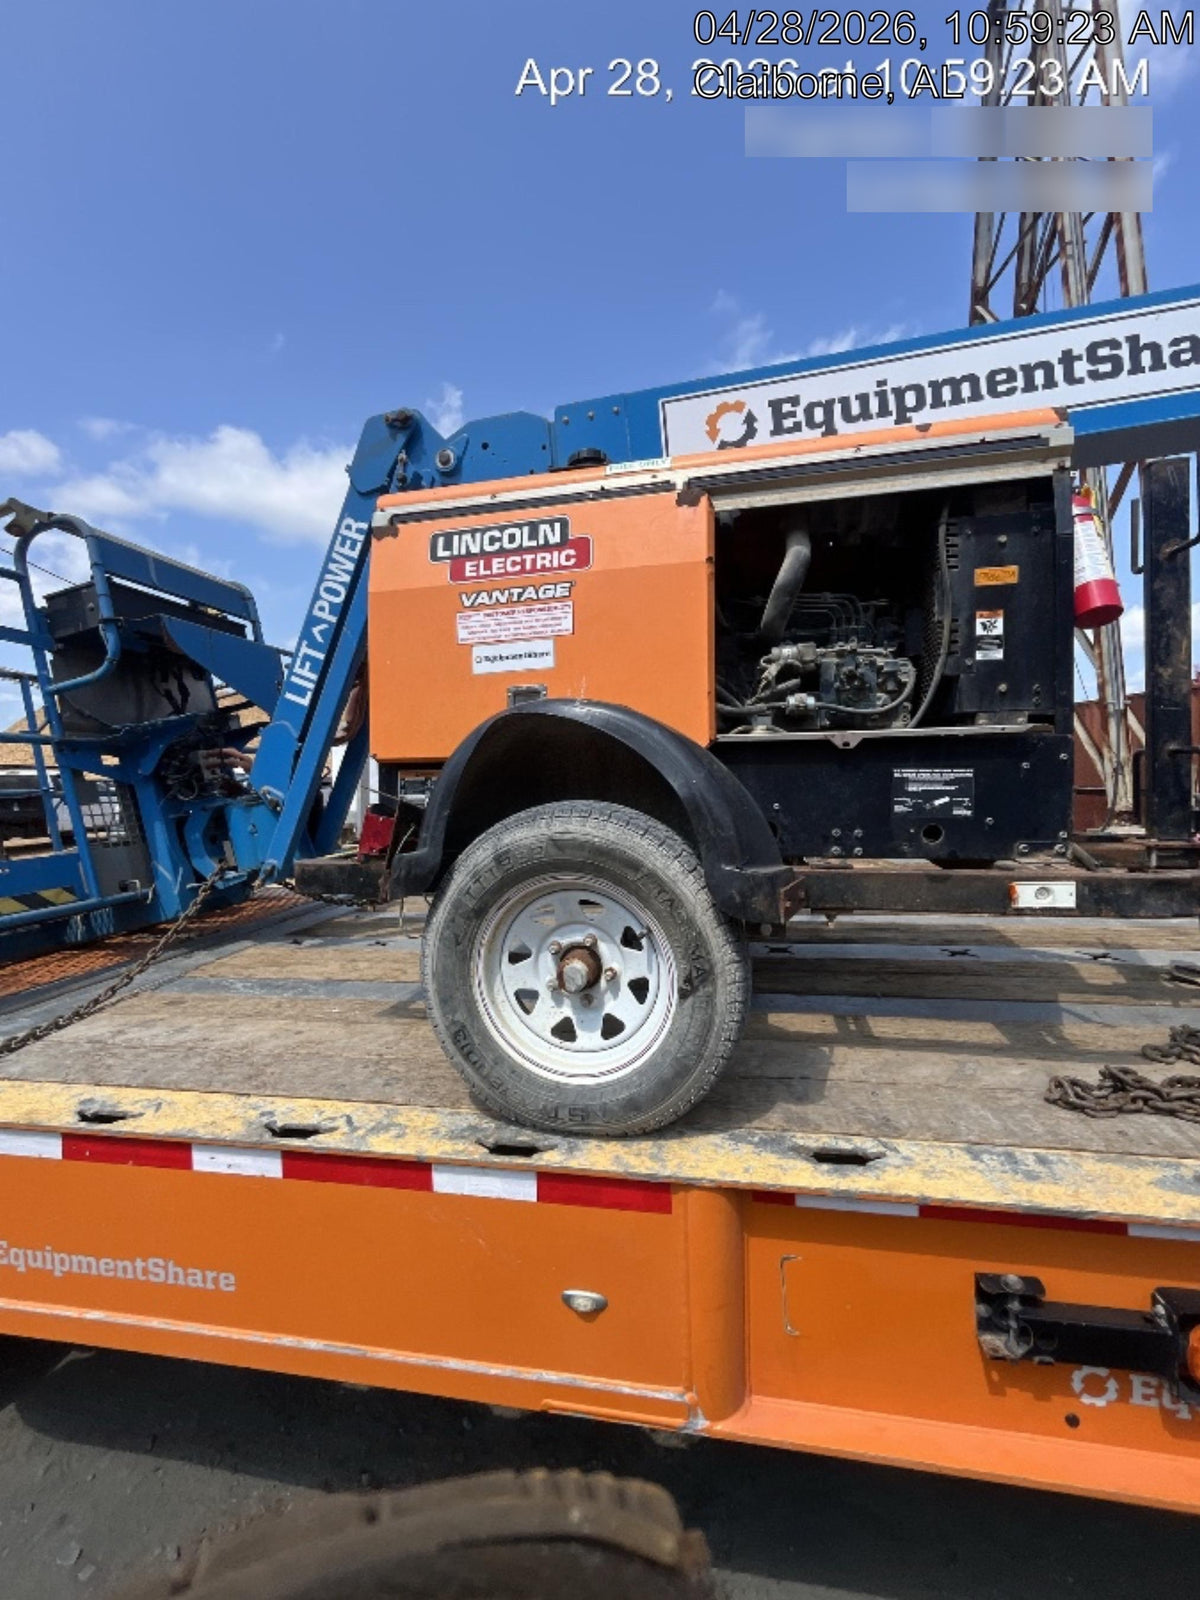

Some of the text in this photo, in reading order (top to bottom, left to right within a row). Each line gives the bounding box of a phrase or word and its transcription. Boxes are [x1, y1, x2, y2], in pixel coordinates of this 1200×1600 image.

[768, 334, 1200, 437] EquipmentSha
[436, 522, 561, 558] LINCOLN
[465, 549, 577, 577] ELECTRIC
[284, 516, 369, 707] LIFT POWER
[459, 581, 571, 607] VANTAGE
